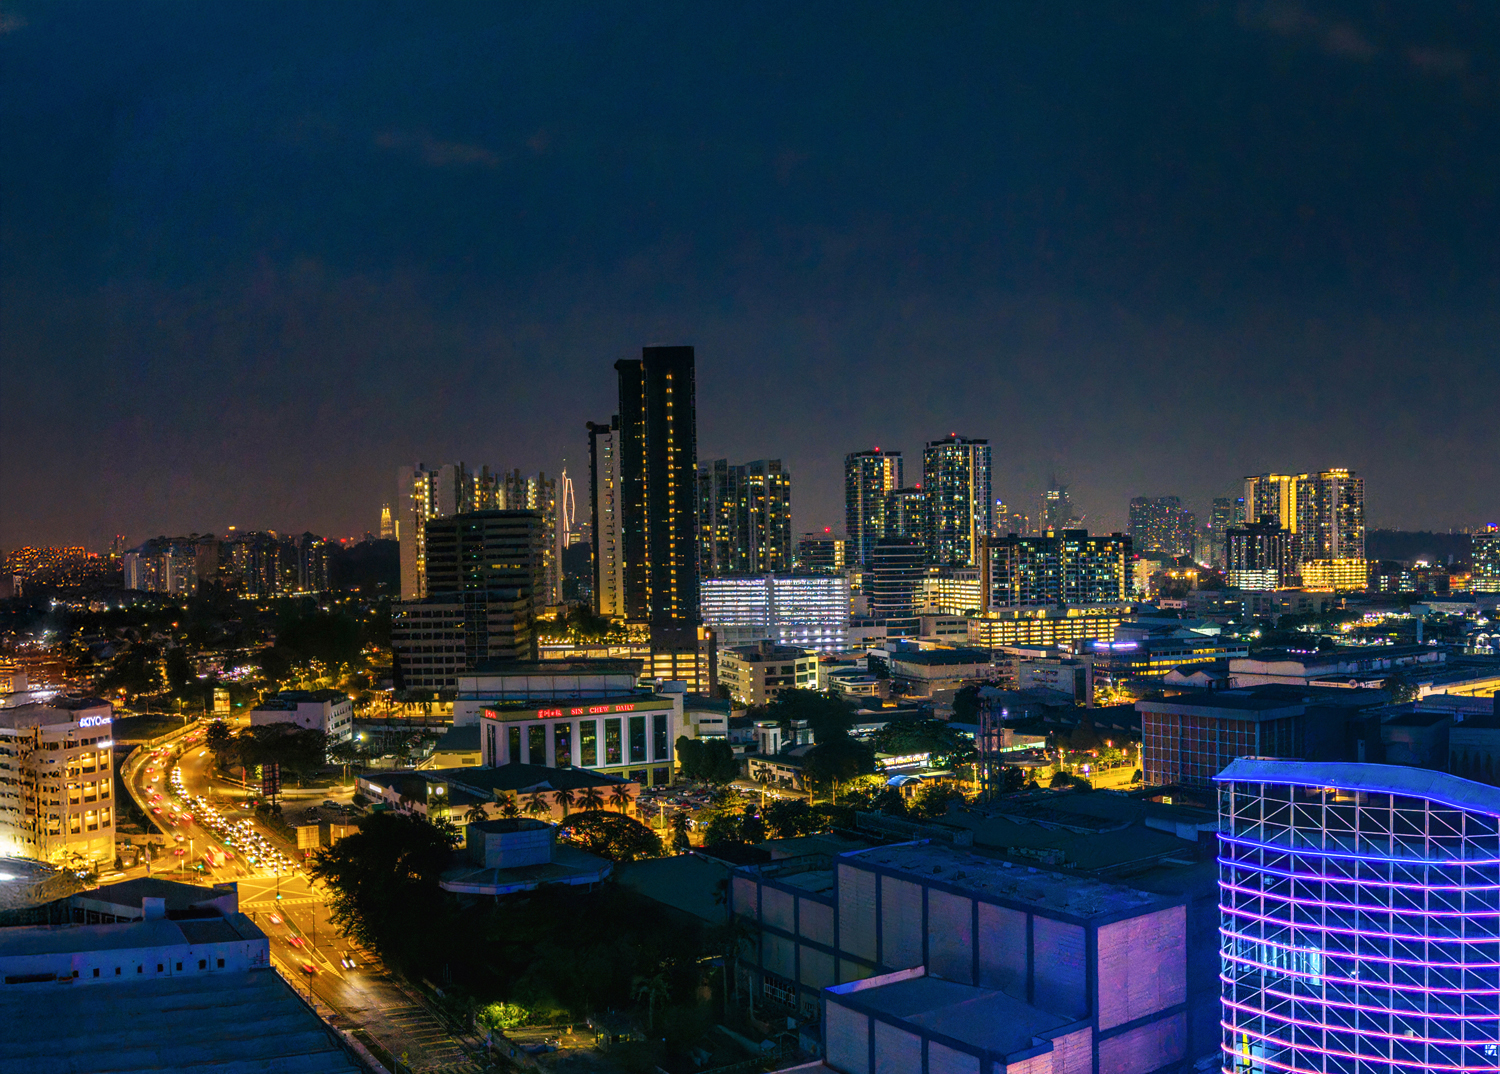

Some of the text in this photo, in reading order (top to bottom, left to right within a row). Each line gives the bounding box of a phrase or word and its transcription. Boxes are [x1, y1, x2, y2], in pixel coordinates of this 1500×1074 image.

[571, 708, 583, 716] SIN
[589, 705, 609, 714] CHEW
[615, 704, 634, 712] DAILY
